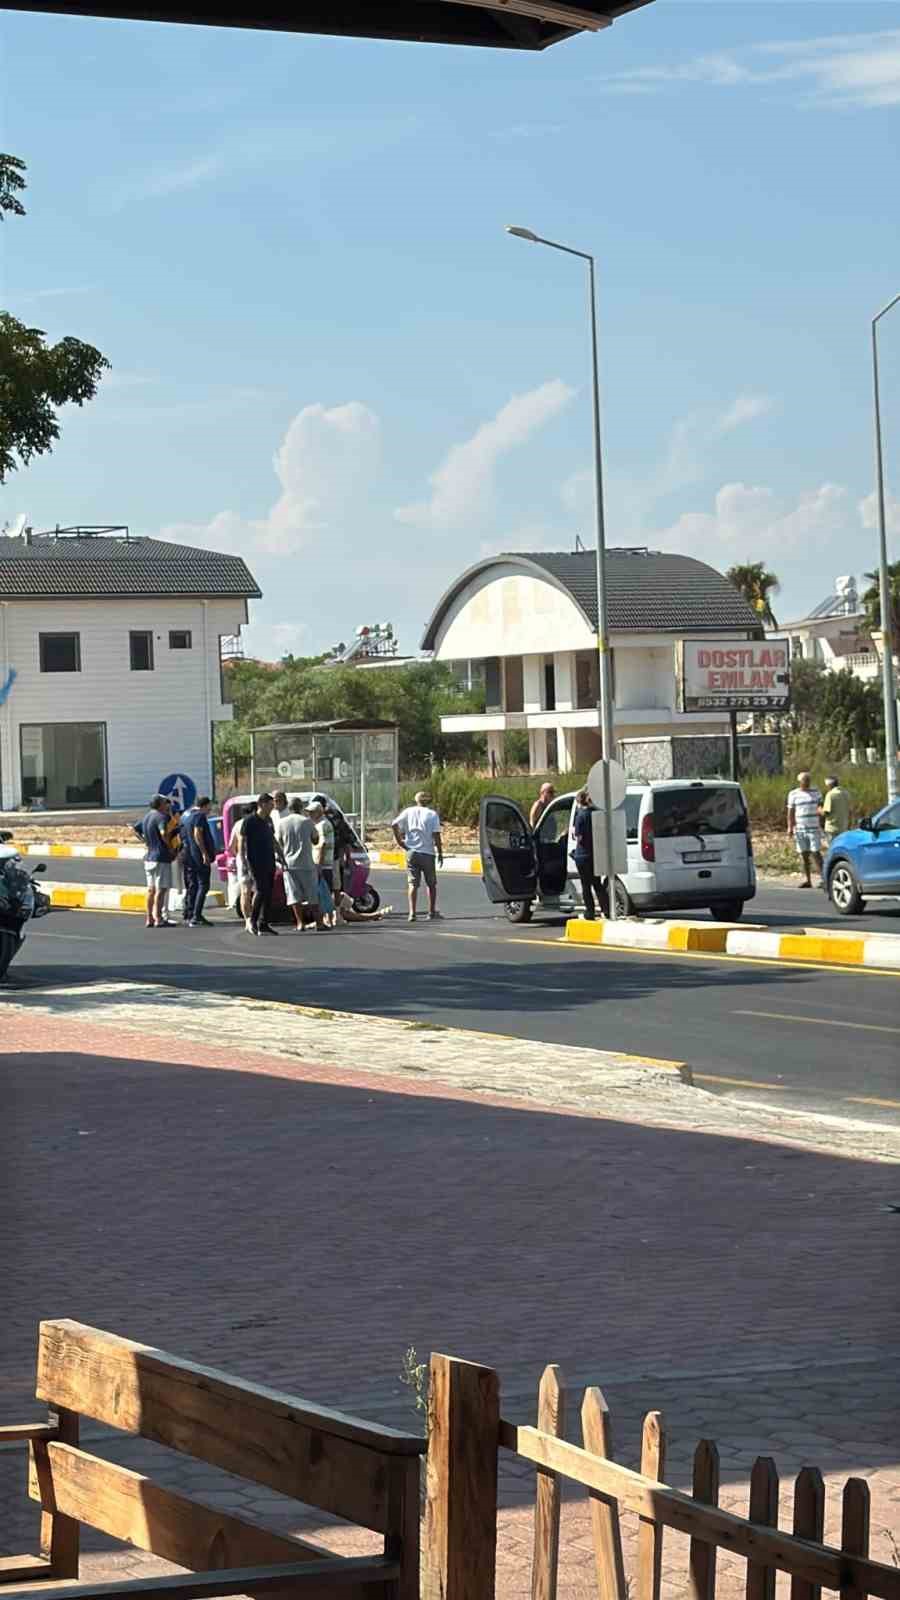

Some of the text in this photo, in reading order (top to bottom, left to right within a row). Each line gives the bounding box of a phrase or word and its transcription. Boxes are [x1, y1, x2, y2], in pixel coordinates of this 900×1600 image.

[697, 648, 785, 668] DOSTLAR
[708, 671, 775, 688] EMLAK
[771, 697, 786, 705] 77
